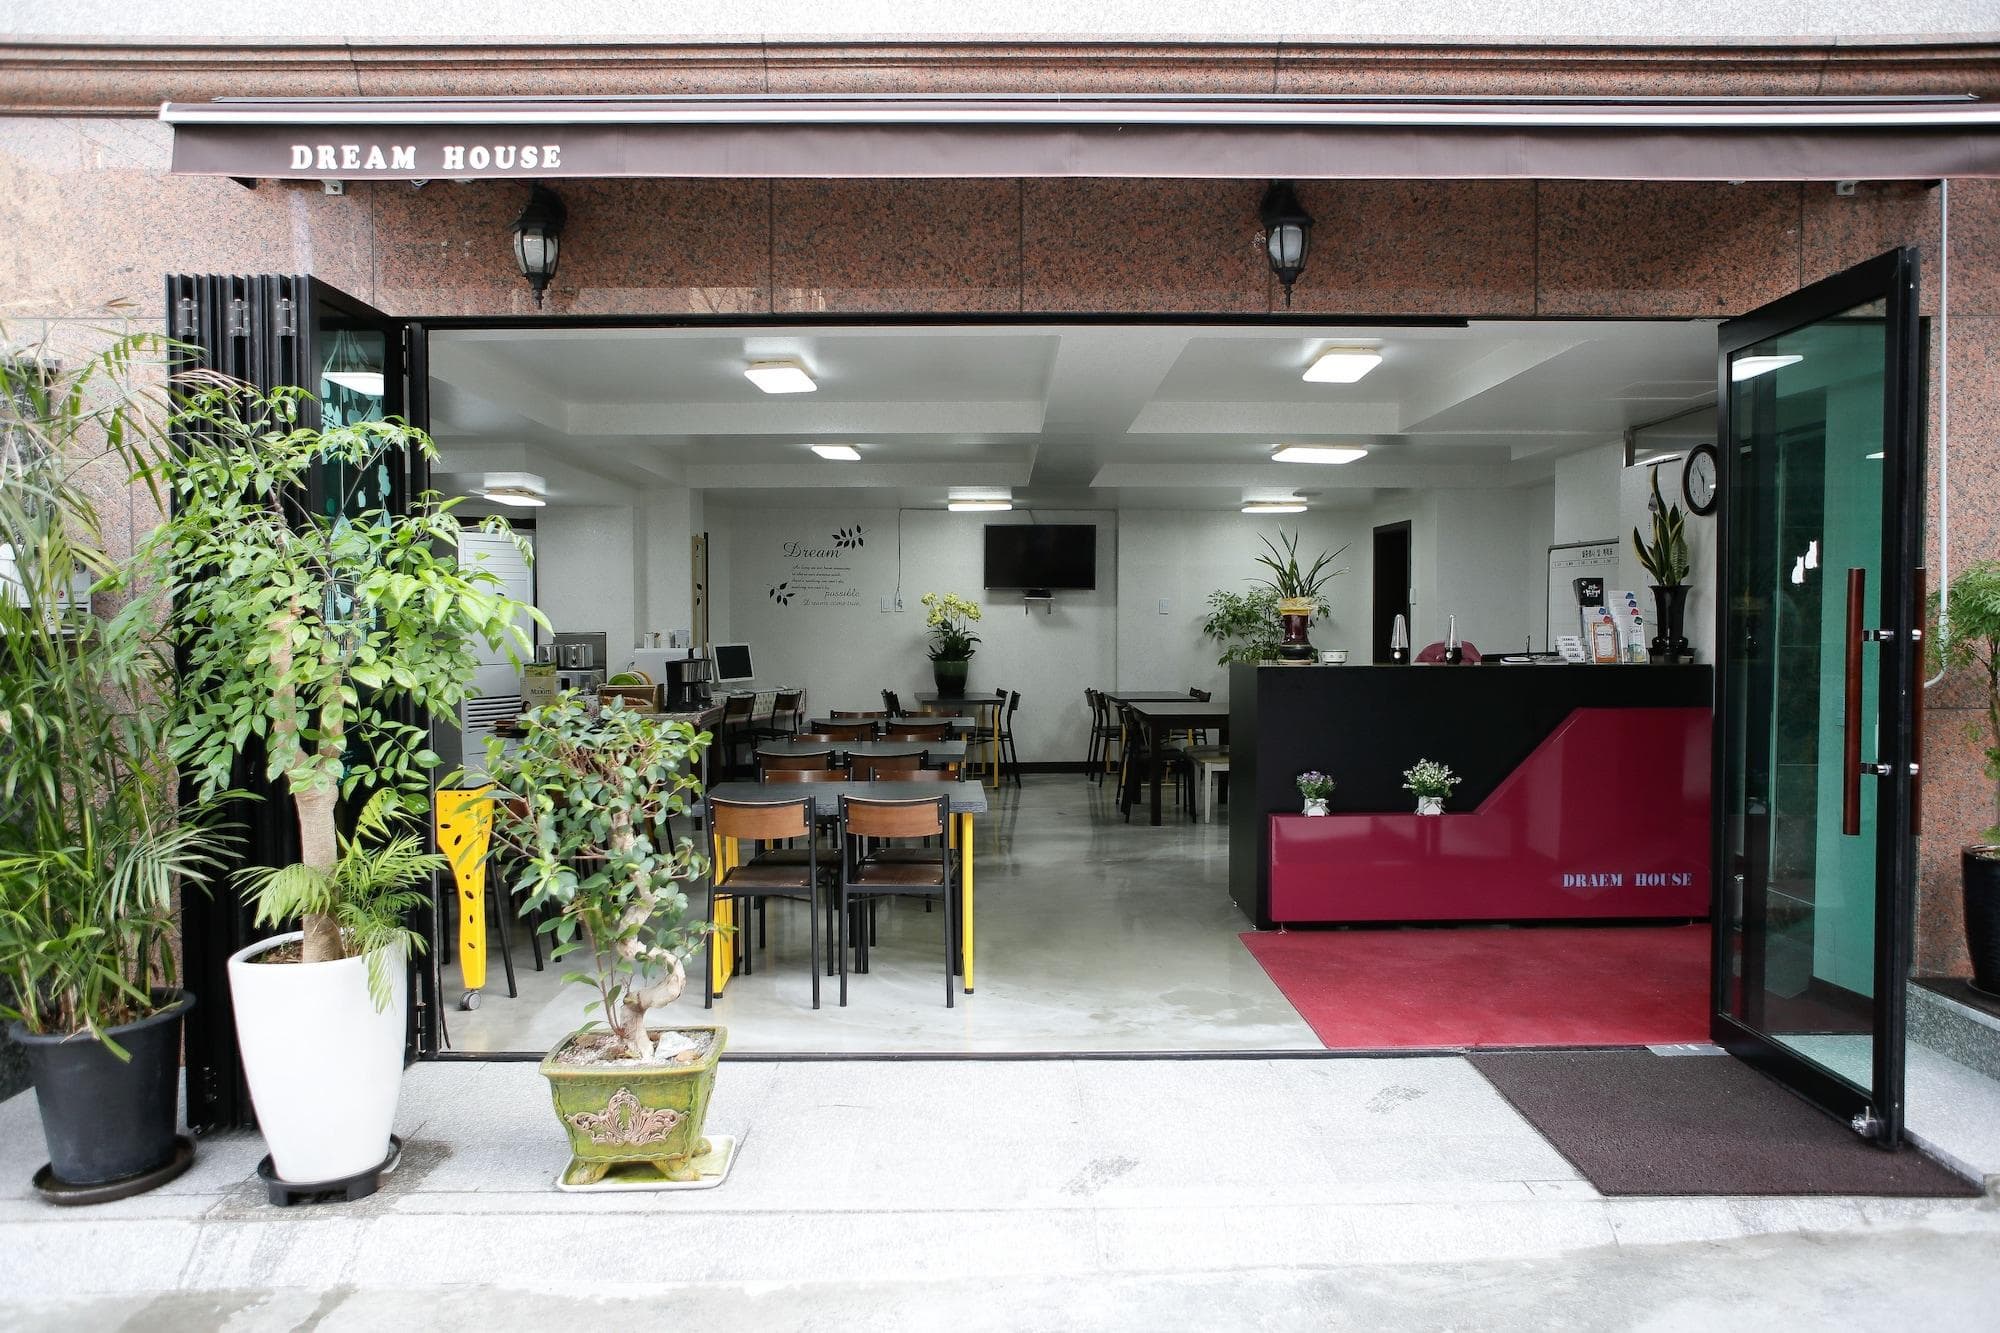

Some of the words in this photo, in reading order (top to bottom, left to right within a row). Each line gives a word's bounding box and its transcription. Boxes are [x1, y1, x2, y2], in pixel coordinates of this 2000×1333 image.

[290, 145, 416, 169] DREAM
[442, 145, 561, 169] HOUSE
[783, 541, 841, 558] Dream
[1563, 873, 1622, 887] DRAEM
[1635, 872, 1692, 886] HOUSE
